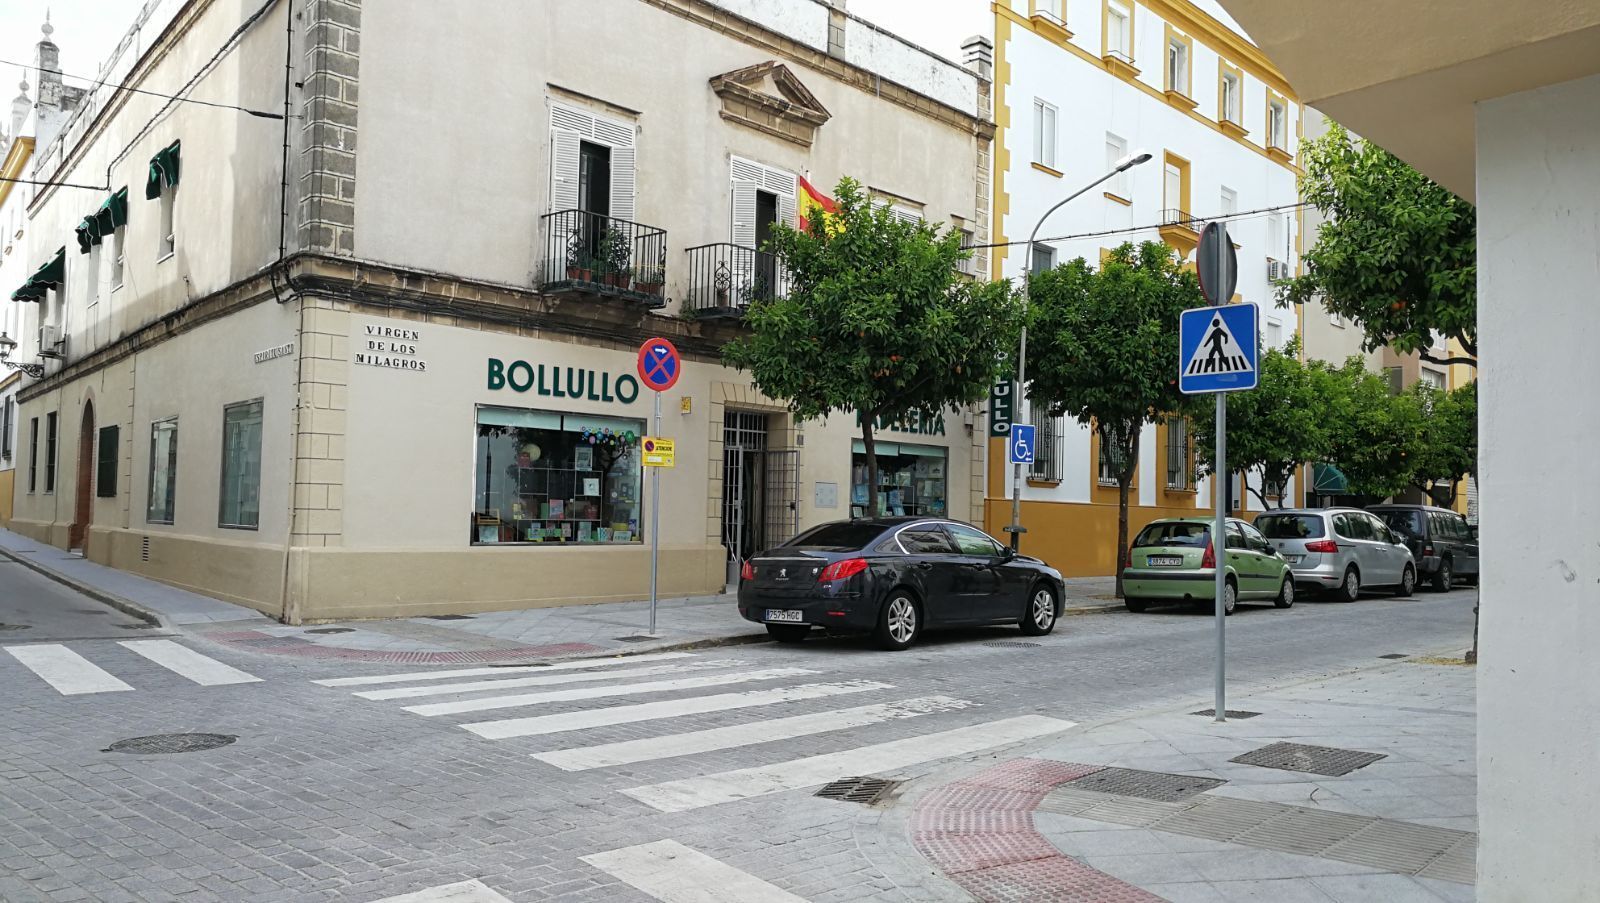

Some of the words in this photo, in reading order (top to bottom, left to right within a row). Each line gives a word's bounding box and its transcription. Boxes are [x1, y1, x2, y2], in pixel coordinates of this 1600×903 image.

[366, 325, 419, 340] VIRGEN
[368, 340, 385, 351] DE
[390, 342, 416, 354] LOS
[355, 353, 426, 370] MILAGROS
[487, 357, 639, 405] BOLLULLO
[769, 610, 786, 620] 7575
